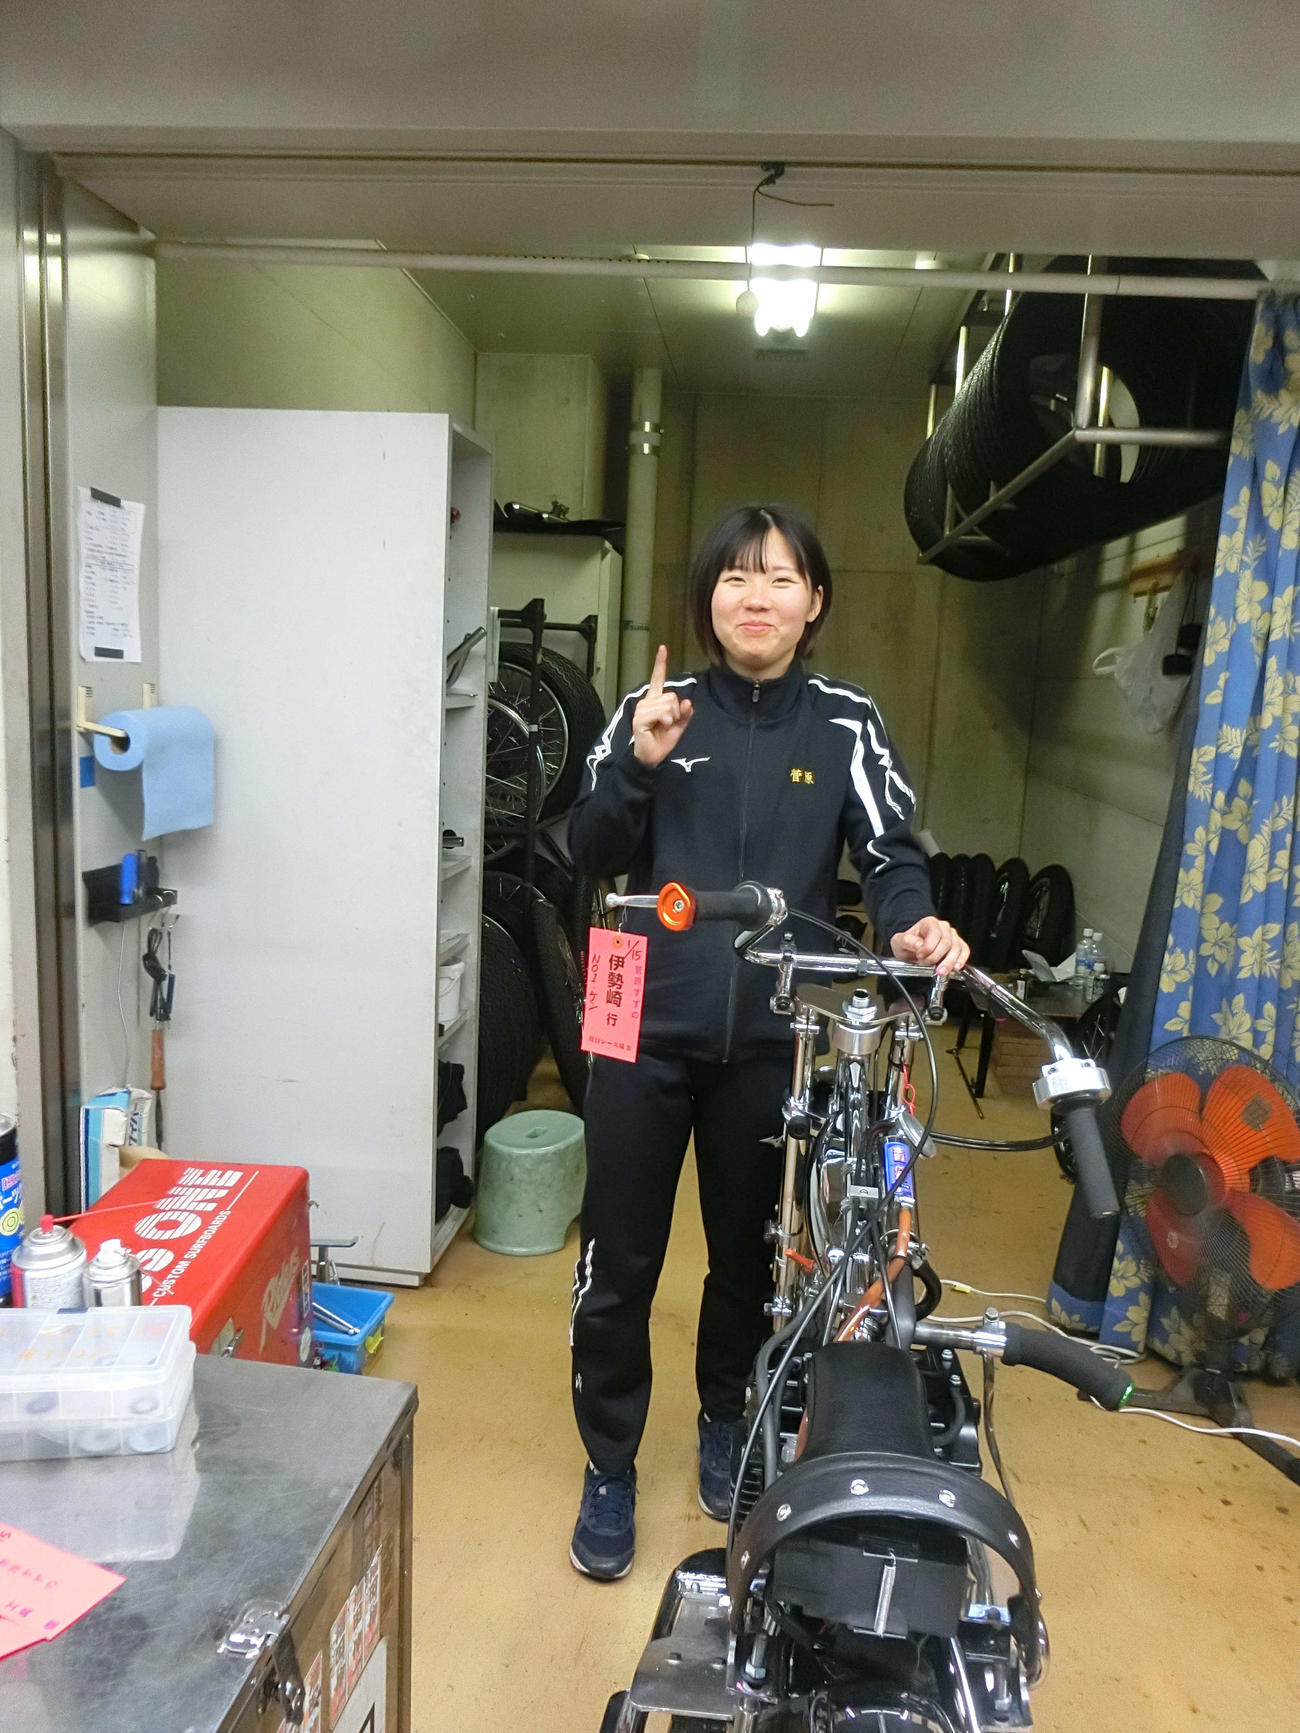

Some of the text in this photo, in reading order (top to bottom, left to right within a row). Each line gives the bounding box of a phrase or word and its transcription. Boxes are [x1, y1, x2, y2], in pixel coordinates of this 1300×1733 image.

[606, 954, 625, 1027] 伊勢崎 行
[135, 1166, 243, 1240] ONE
[154, 1209, 232, 1298] CUSTOM SURFBOARDS
